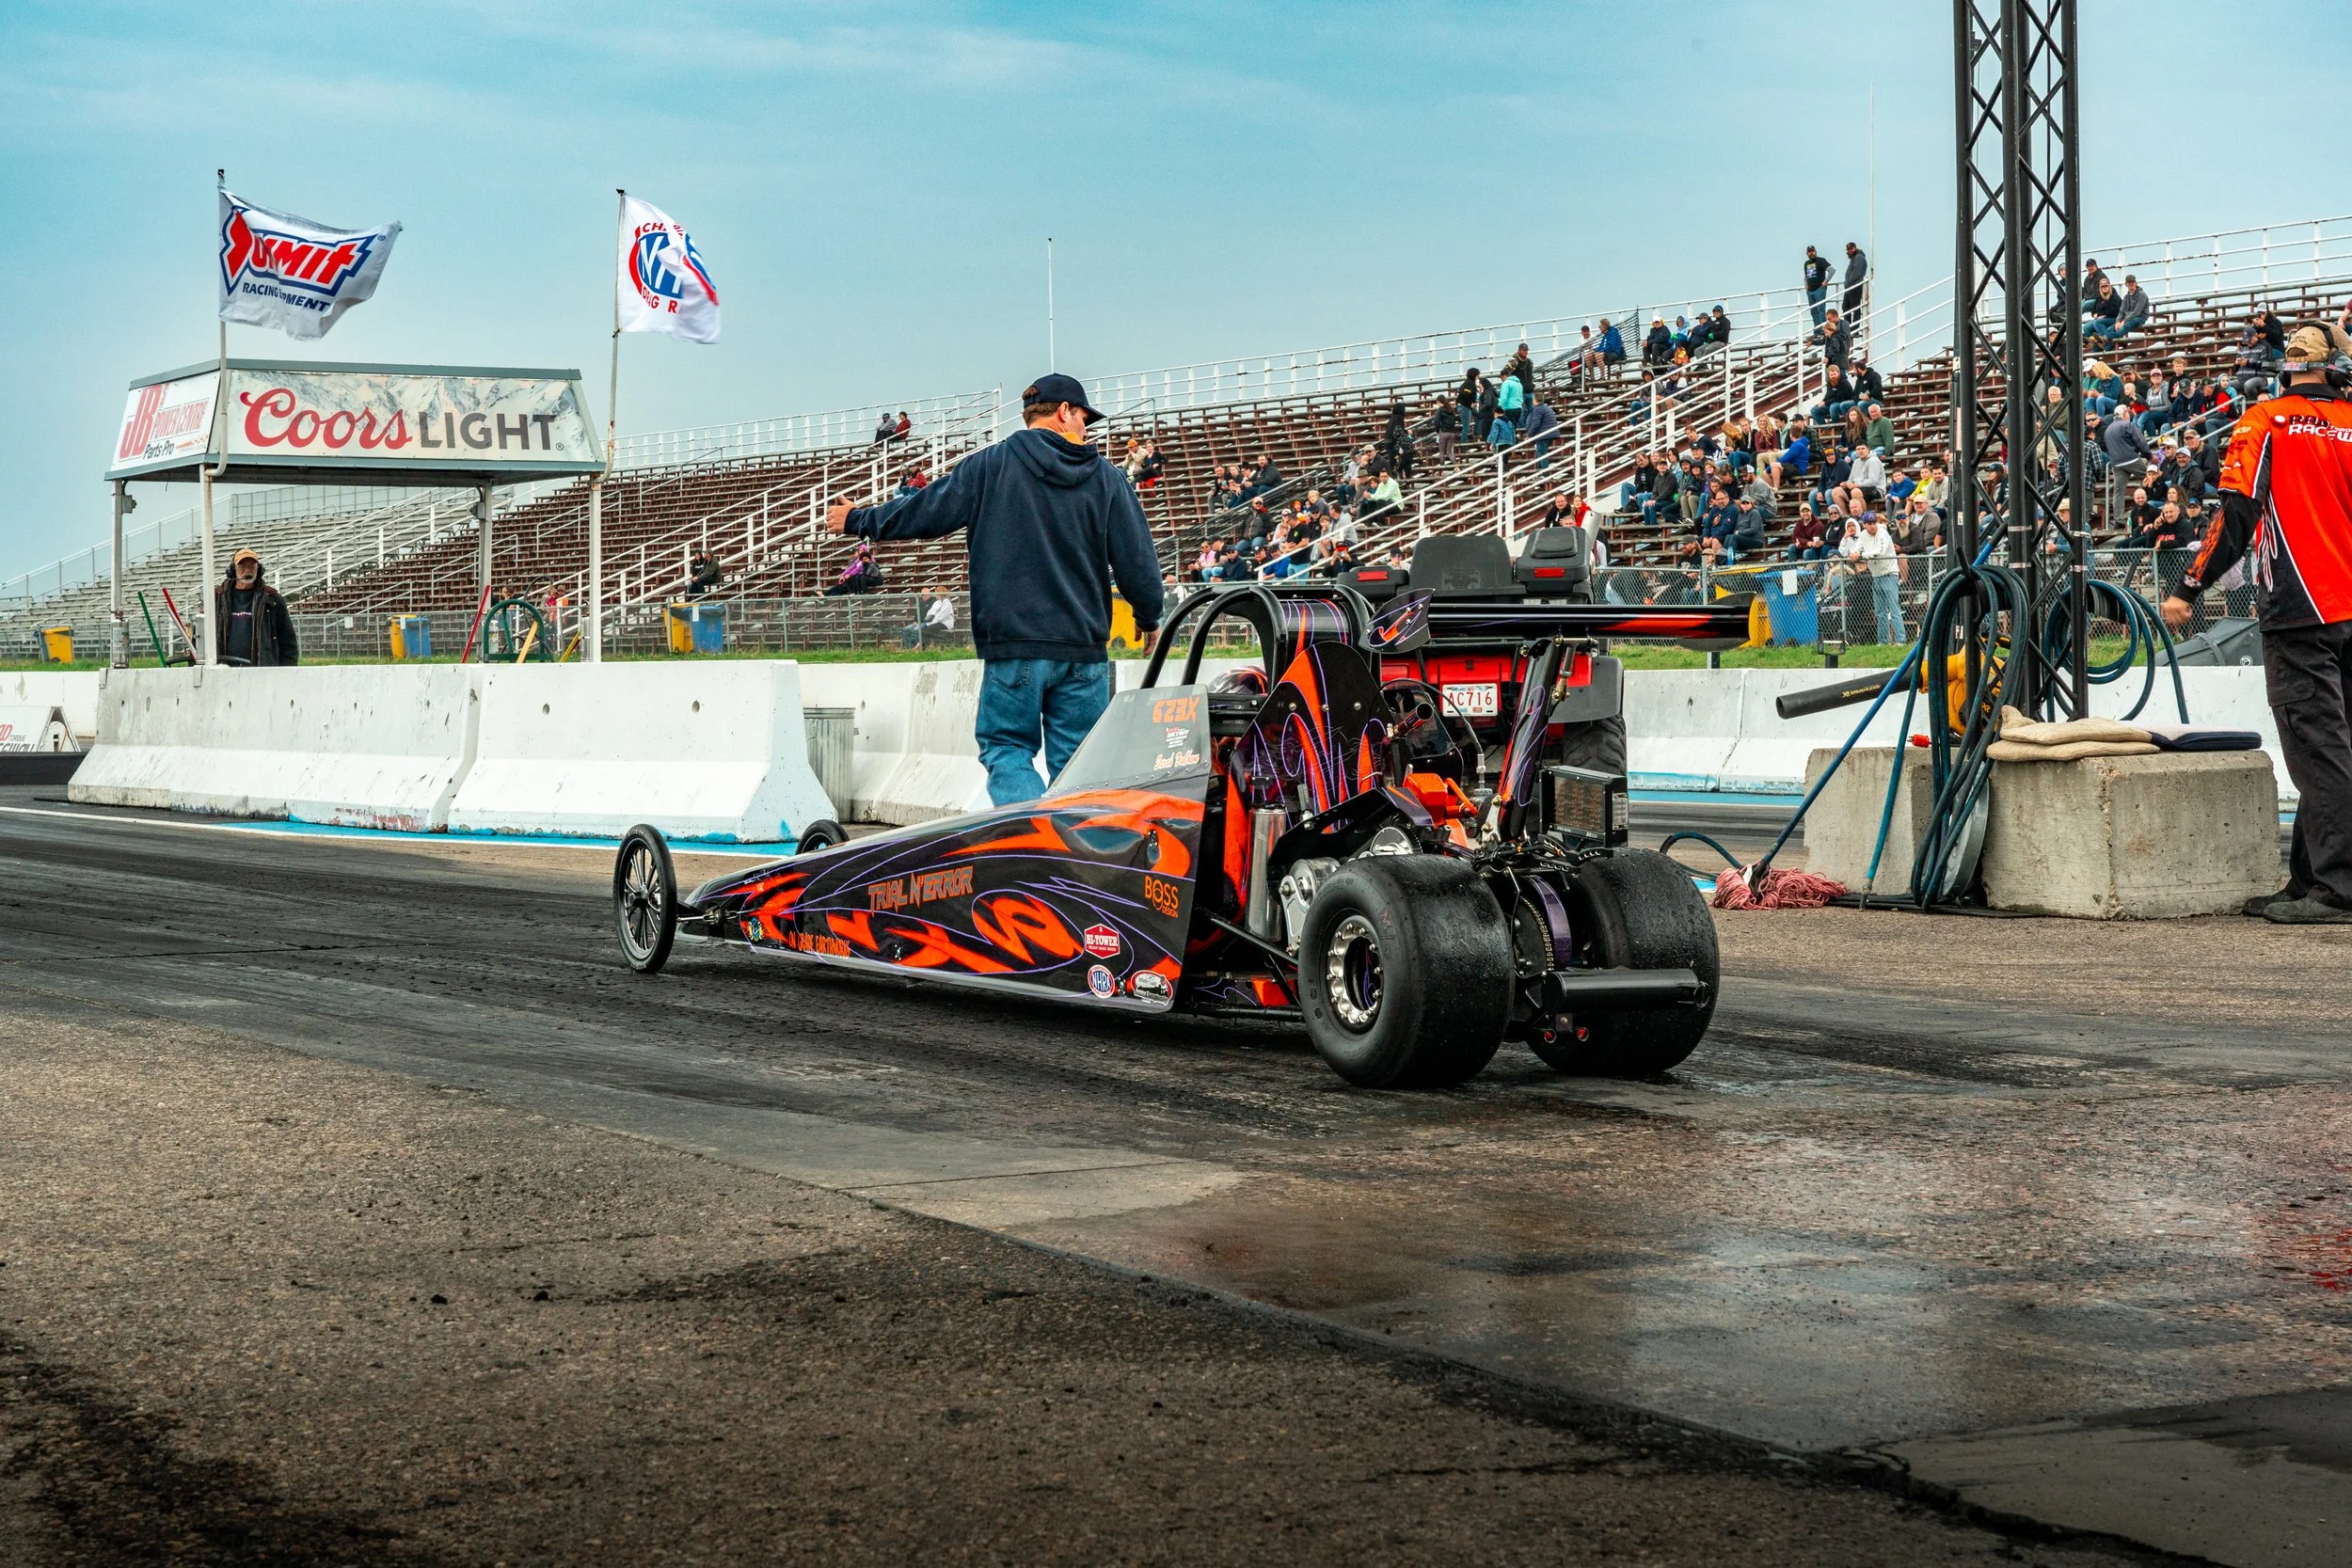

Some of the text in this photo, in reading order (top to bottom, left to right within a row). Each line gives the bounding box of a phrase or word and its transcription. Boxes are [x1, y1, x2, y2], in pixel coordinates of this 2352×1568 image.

[242, 281, 279, 298] RACING
[240, 388, 557, 451] Coors LIGHT
[1152, 693, 1201, 724] 623X
[1447, 691, 1493, 706] AC716
[867, 879, 908, 918] TRIAL
[1145, 875, 1180, 910] BOSS
[1161, 906, 1179, 919] DESIGN
[1086, 934, 1119, 947] HI-TOWER
[1091, 971, 1112, 992] NHRA
